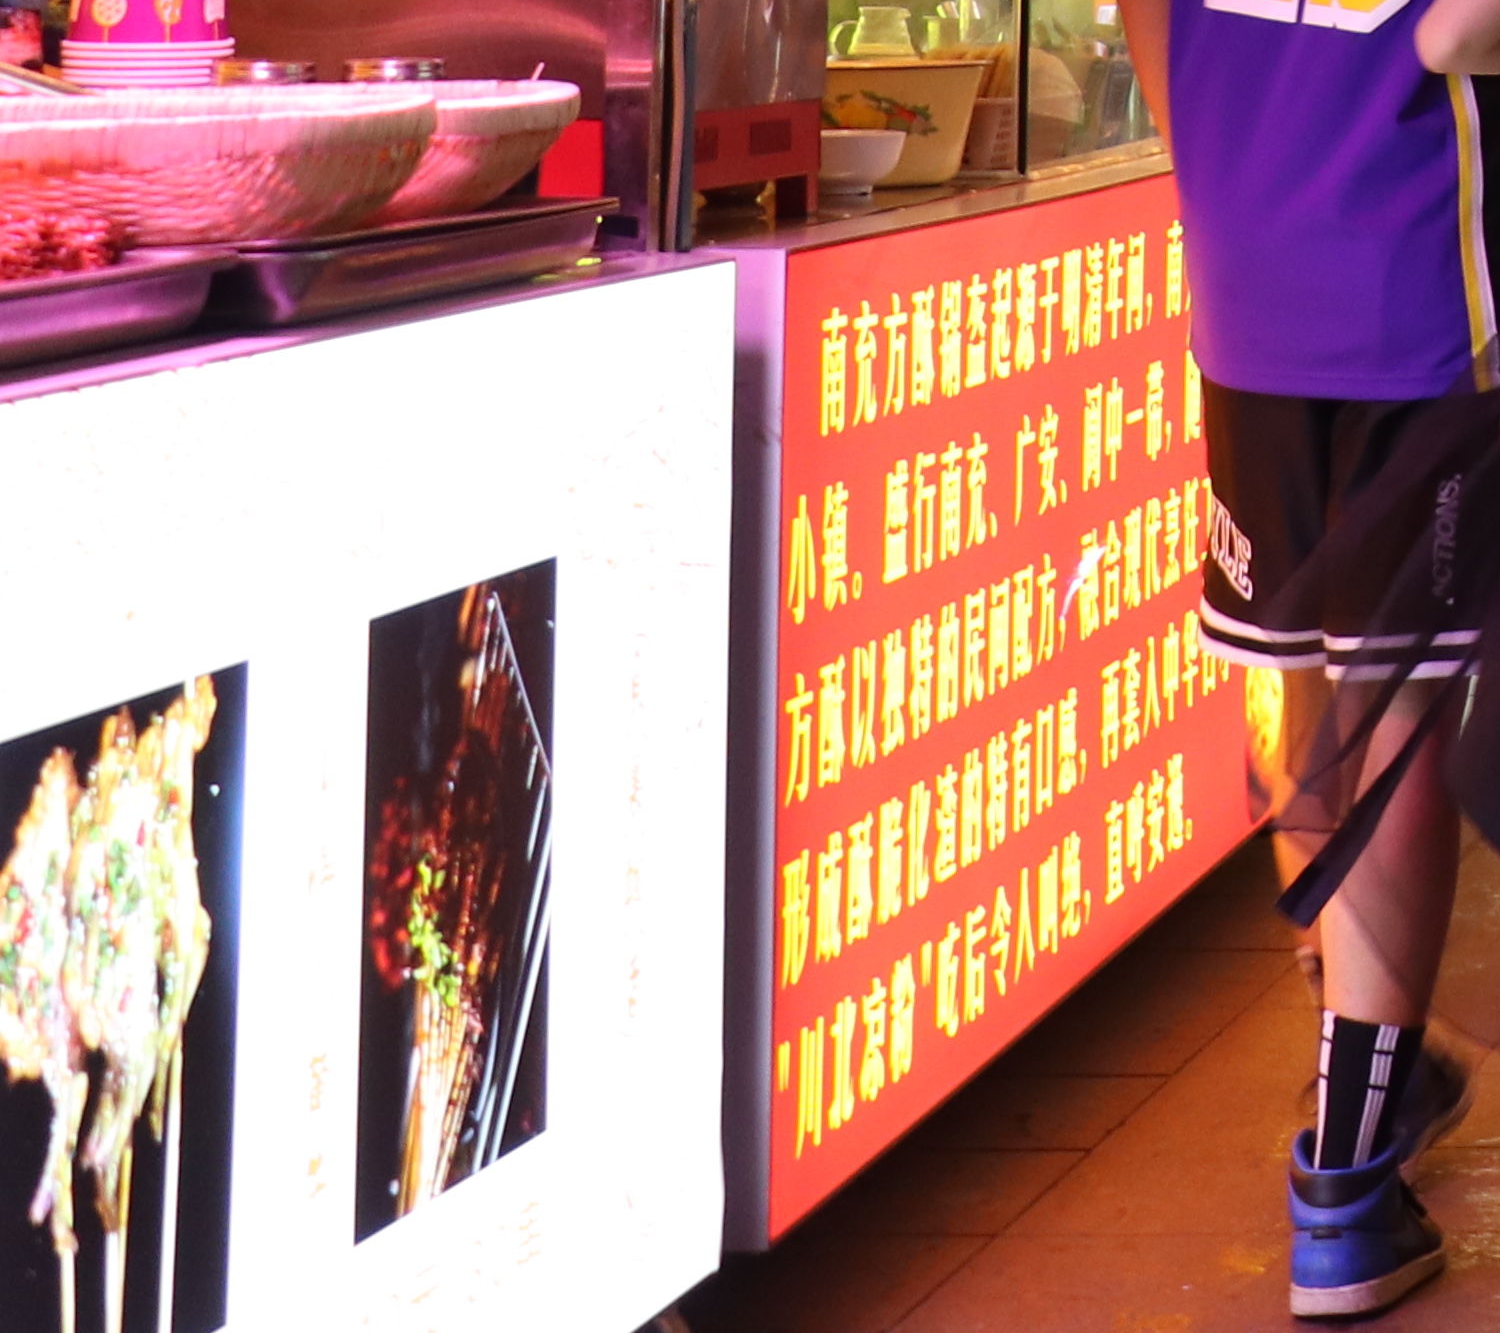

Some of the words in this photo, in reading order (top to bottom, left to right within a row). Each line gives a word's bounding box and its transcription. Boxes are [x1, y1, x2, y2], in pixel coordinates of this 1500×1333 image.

[820, 219, 1190, 438] 南充方酥锅盔起源于明清年间，南
